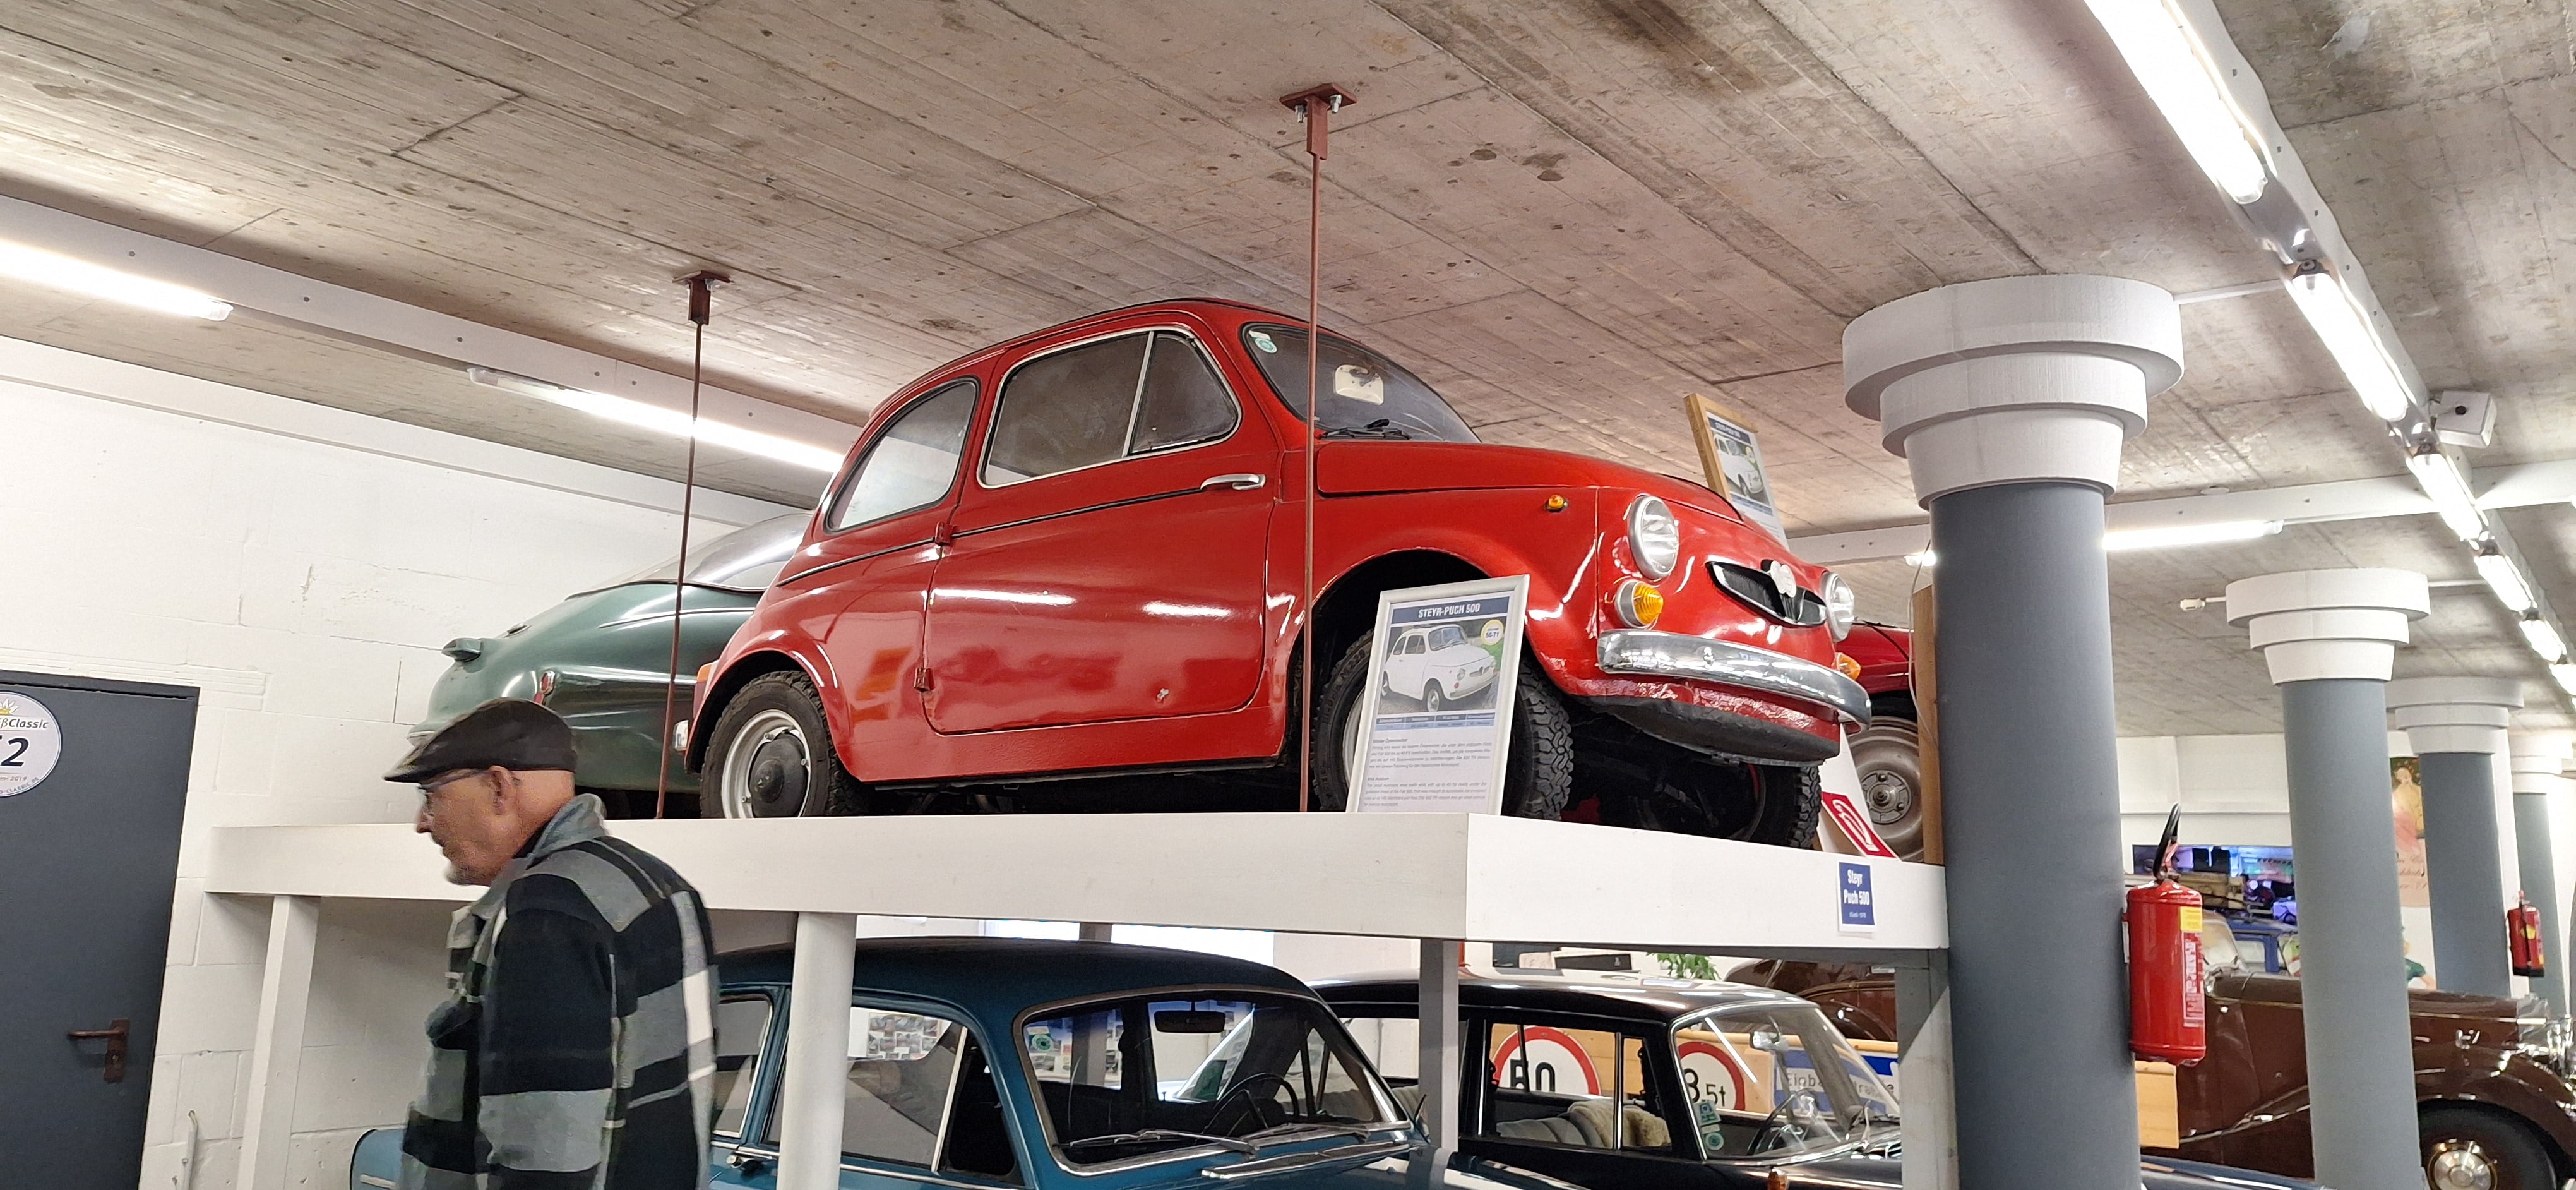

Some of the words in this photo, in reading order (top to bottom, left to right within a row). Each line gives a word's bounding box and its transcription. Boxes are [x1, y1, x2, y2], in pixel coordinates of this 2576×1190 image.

[1418, 604, 1464, 618] STEYR-PUCH
[1465, 603, 1481, 613] 500
[0, 718, 49, 729] ßClassic
[0, 735, 29, 767] 2
[1847, 869, 1863, 887] Steyr
[1844, 889, 1858, 904] Puch
[1859, 891, 1870, 905] 500
